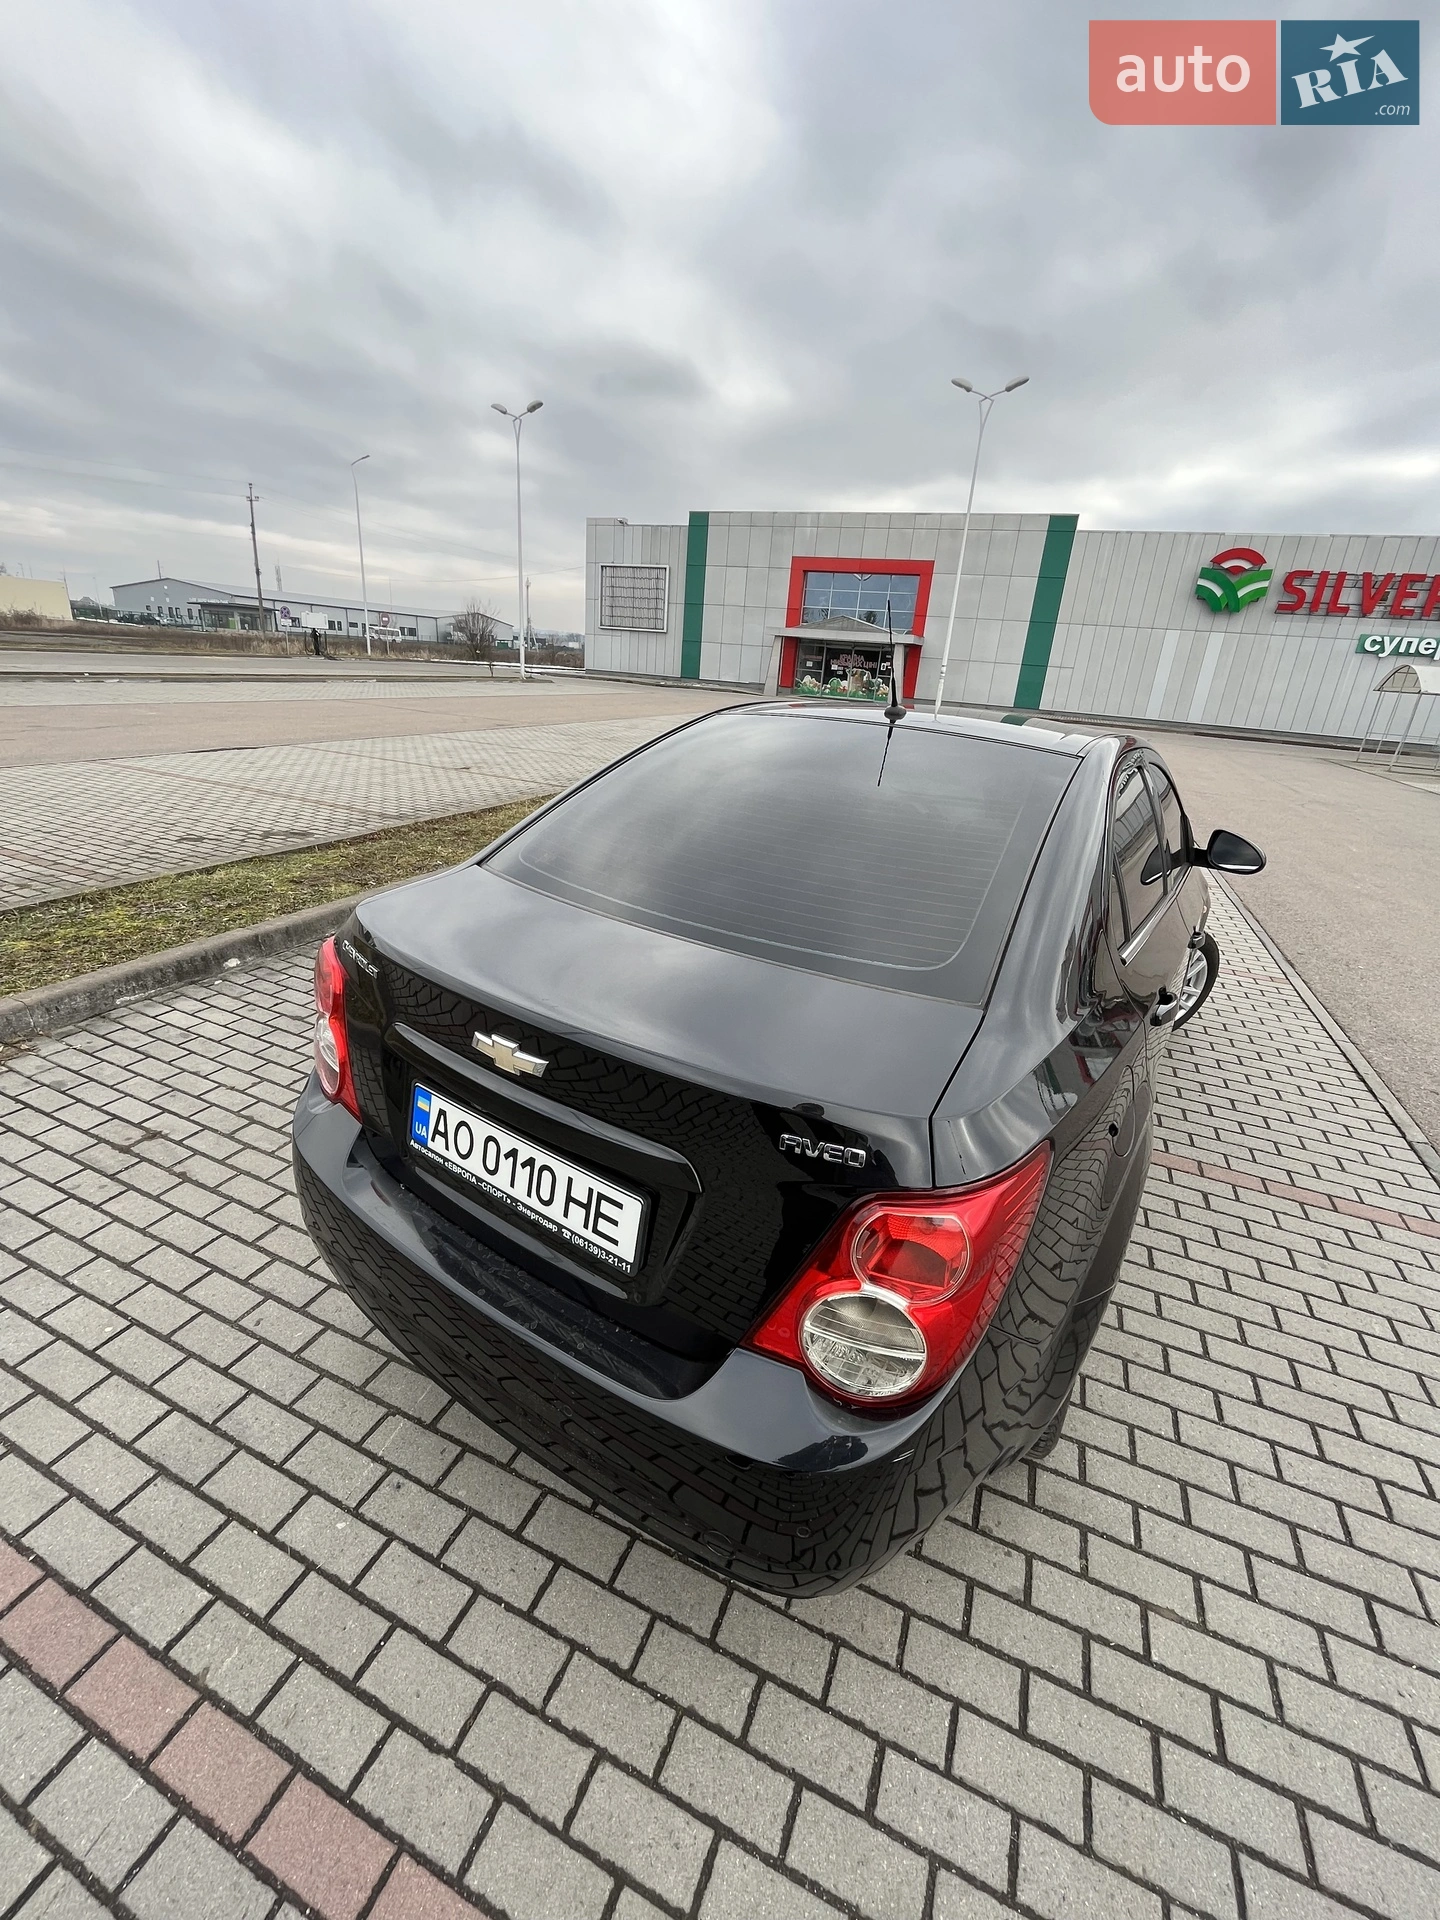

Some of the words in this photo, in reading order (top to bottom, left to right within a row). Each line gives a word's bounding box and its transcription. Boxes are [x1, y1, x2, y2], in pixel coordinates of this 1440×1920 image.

[414, 1121, 427, 1138] UA
[779, 1133, 867, 1169] AVEO
[430, 1108, 474, 1160] AO
[482, 1135, 557, 1207] 0110
[563, 1175, 624, 1247] HE
